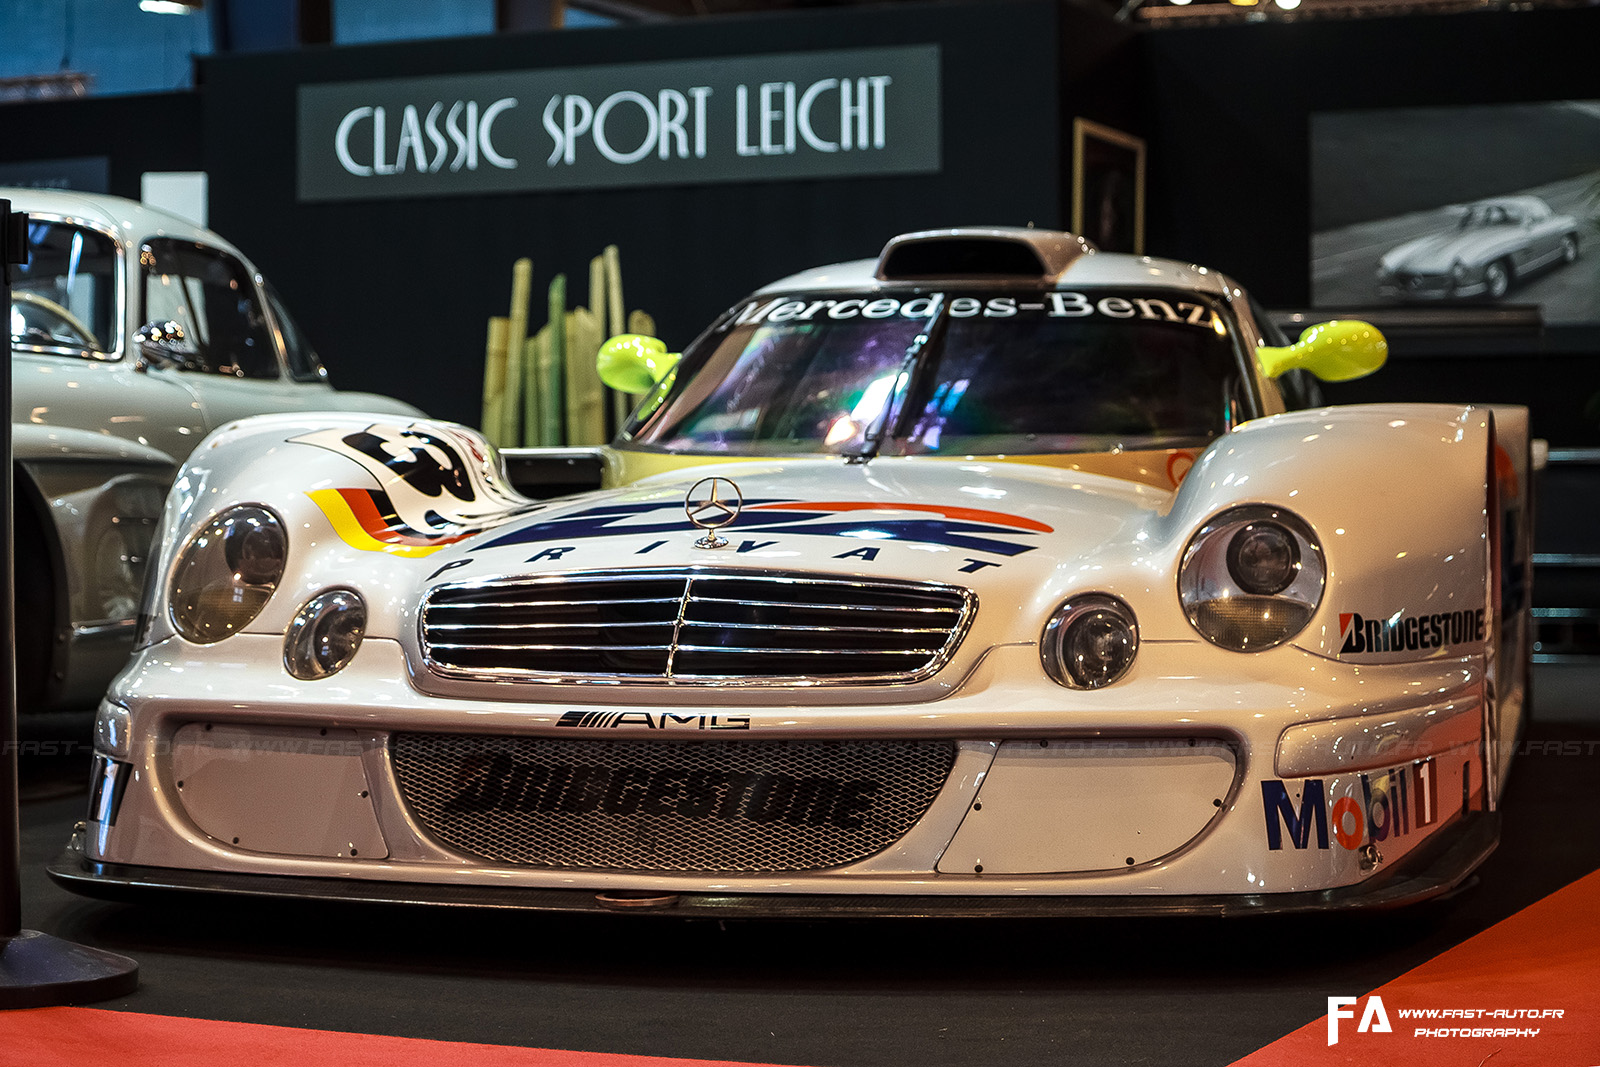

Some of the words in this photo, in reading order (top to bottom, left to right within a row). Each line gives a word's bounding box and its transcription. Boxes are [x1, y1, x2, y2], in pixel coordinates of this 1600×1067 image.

[334, 97, 518, 177] CLASSIC
[542, 86, 714, 168] SPORT
[736, 76, 893, 156] LEICHT
[715, 292, 1214, 332] Mercedes-Benz
[1339, 608, 1485, 654] BRIDGESTONE
[610, 711, 750, 730] AMG
[1260, 768, 1409, 850] Mobil
